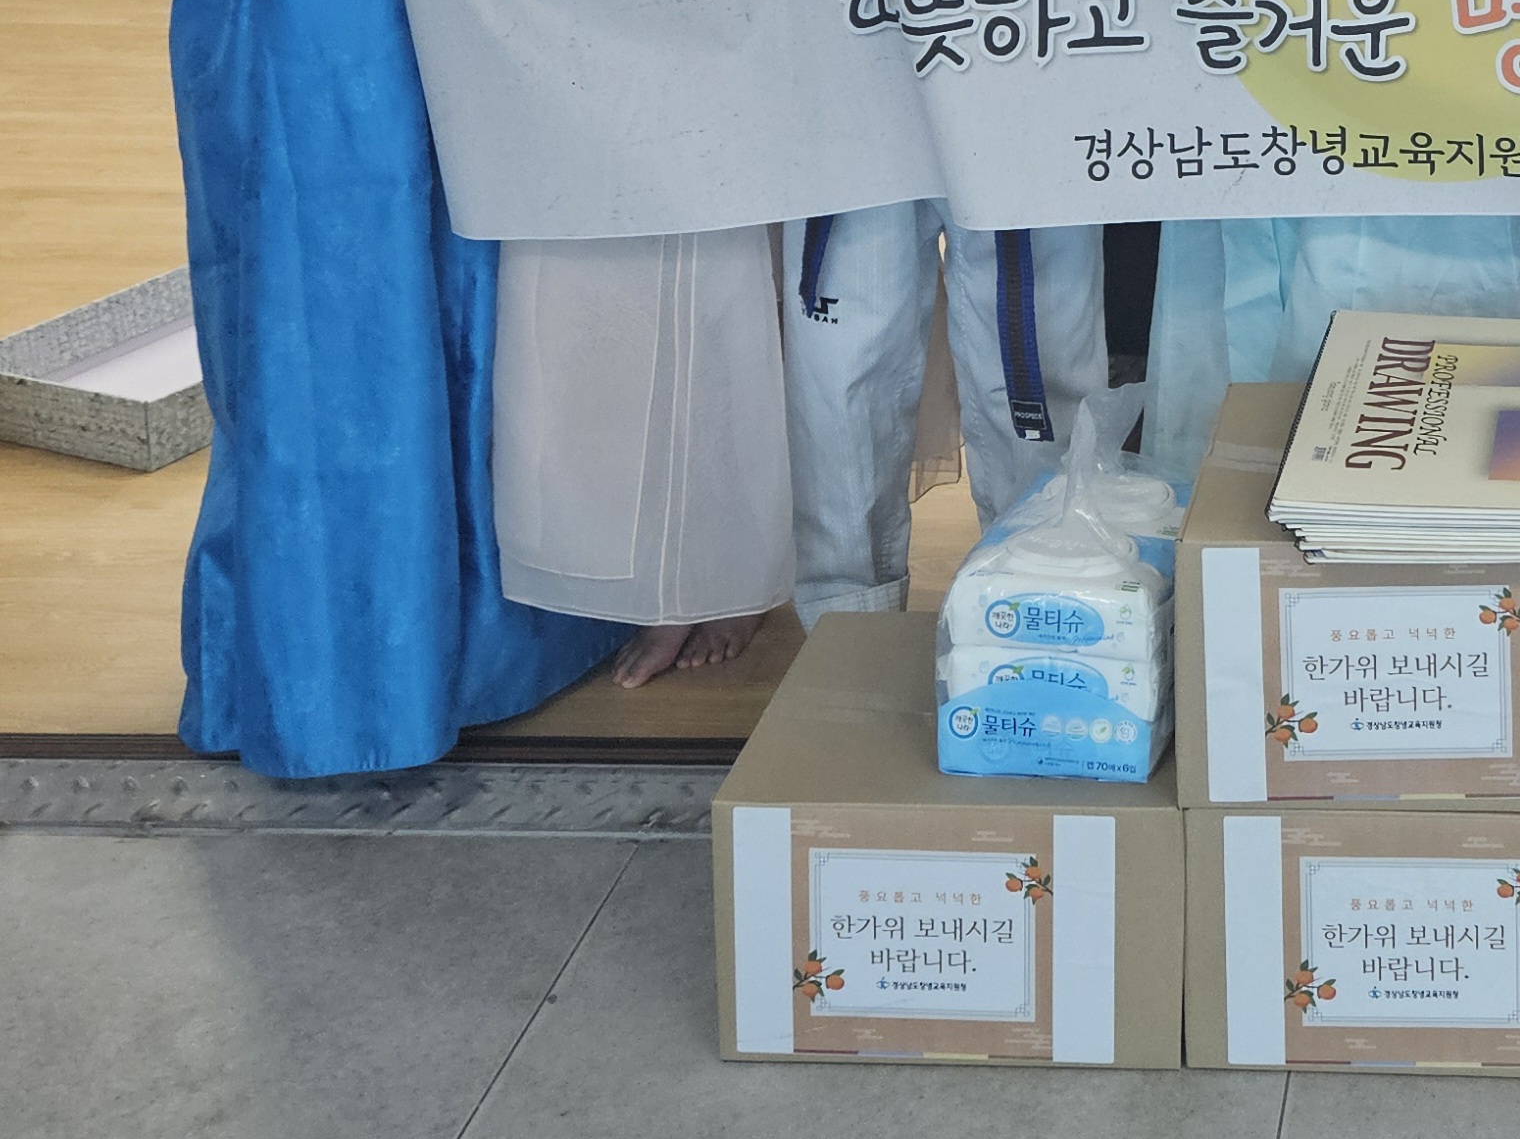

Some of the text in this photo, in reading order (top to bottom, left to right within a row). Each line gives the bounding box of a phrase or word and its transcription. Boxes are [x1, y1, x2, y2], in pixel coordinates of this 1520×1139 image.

[1345, 337, 1436, 470] DRAWING
[1413, 355, 1459, 455] PROFESSIONAL
[1023, 606, 1084, 633] 물티슈
[1302, 652, 1489, 681] 한가위 보내시길
[1344, 686, 1452, 712] 바랍니다.
[982, 714, 1036, 738] 물티슈
[830, 914, 1014, 944] 한가위 보내시길
[1322, 923, 1506, 950] 한가위 보내시길
[870, 948, 976, 974] 바랍니다.
[1362, 957, 1469, 982] 바랍니다.
